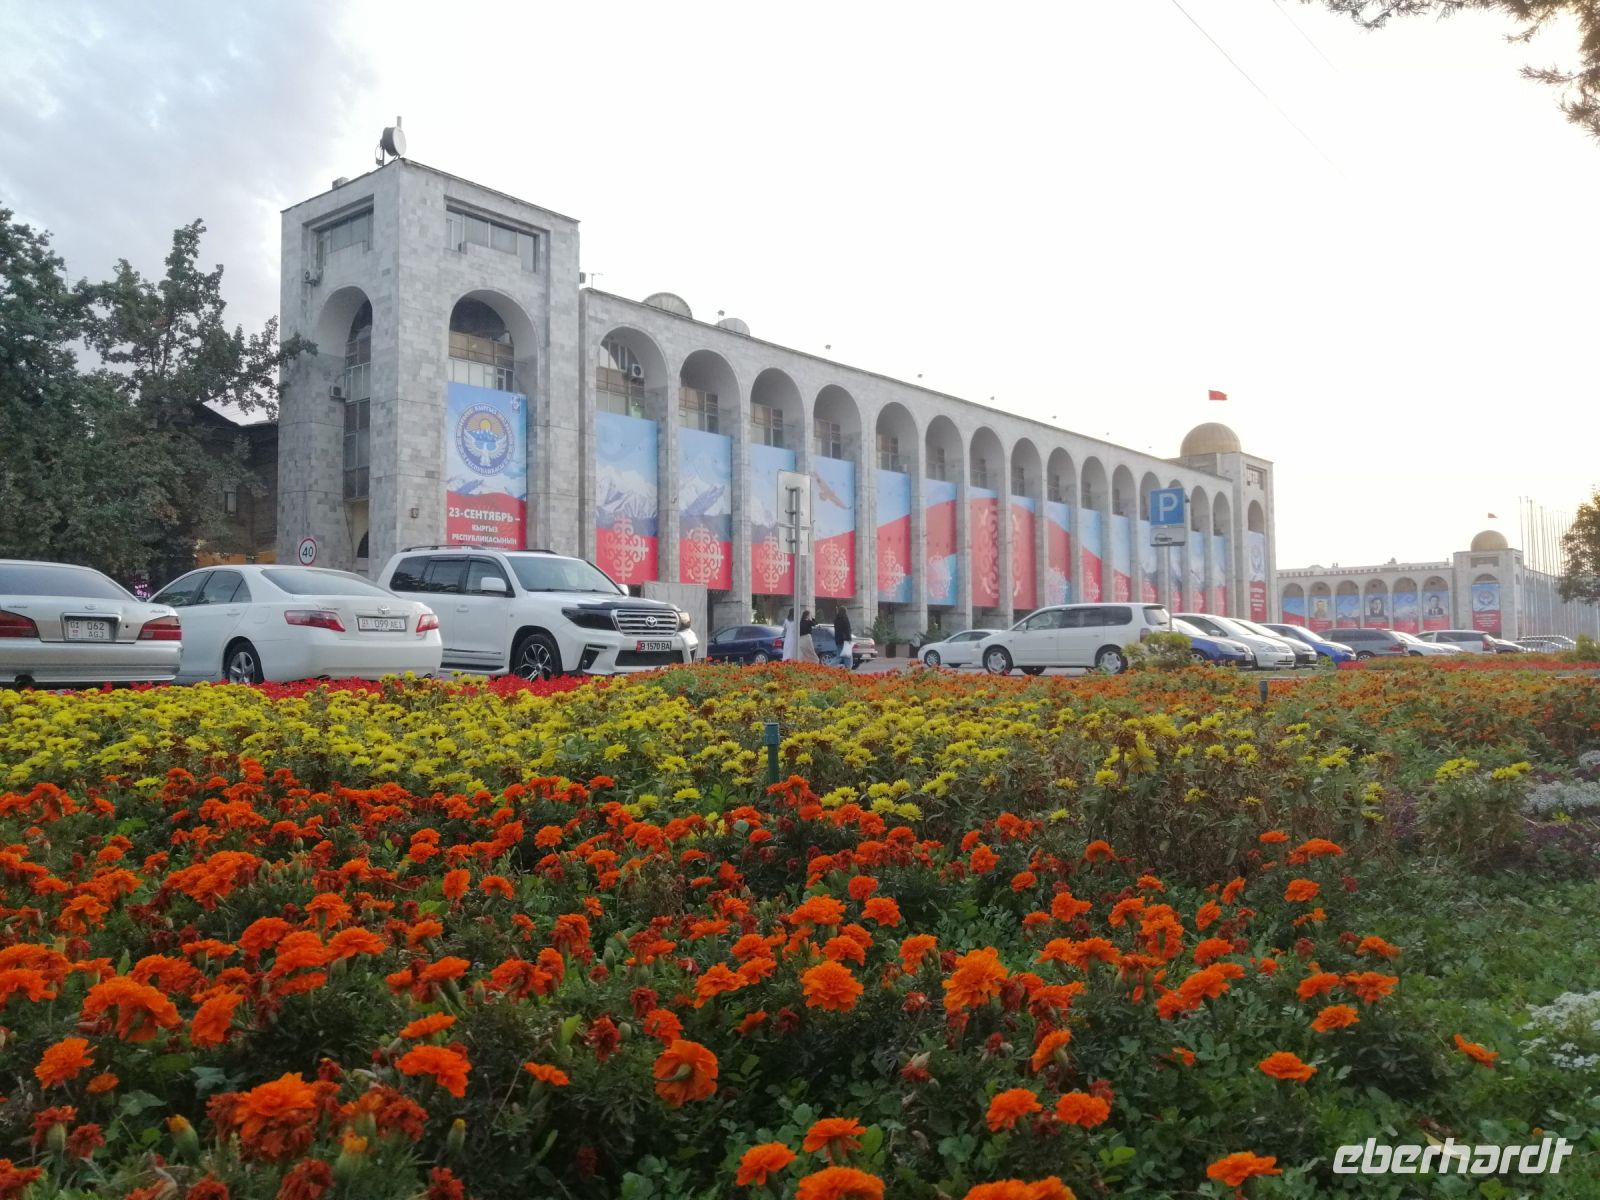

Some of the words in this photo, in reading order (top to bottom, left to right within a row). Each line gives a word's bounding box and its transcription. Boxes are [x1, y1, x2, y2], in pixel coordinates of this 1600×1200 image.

[1159, 493, 1178, 521] P
[448, 507, 513, 522] 23-СЕНТЯБРЬ
[471, 524, 498, 533] КЫРГЫЗ
[302, 546, 313, 558] 40
[88, 621, 105, 631] 062
